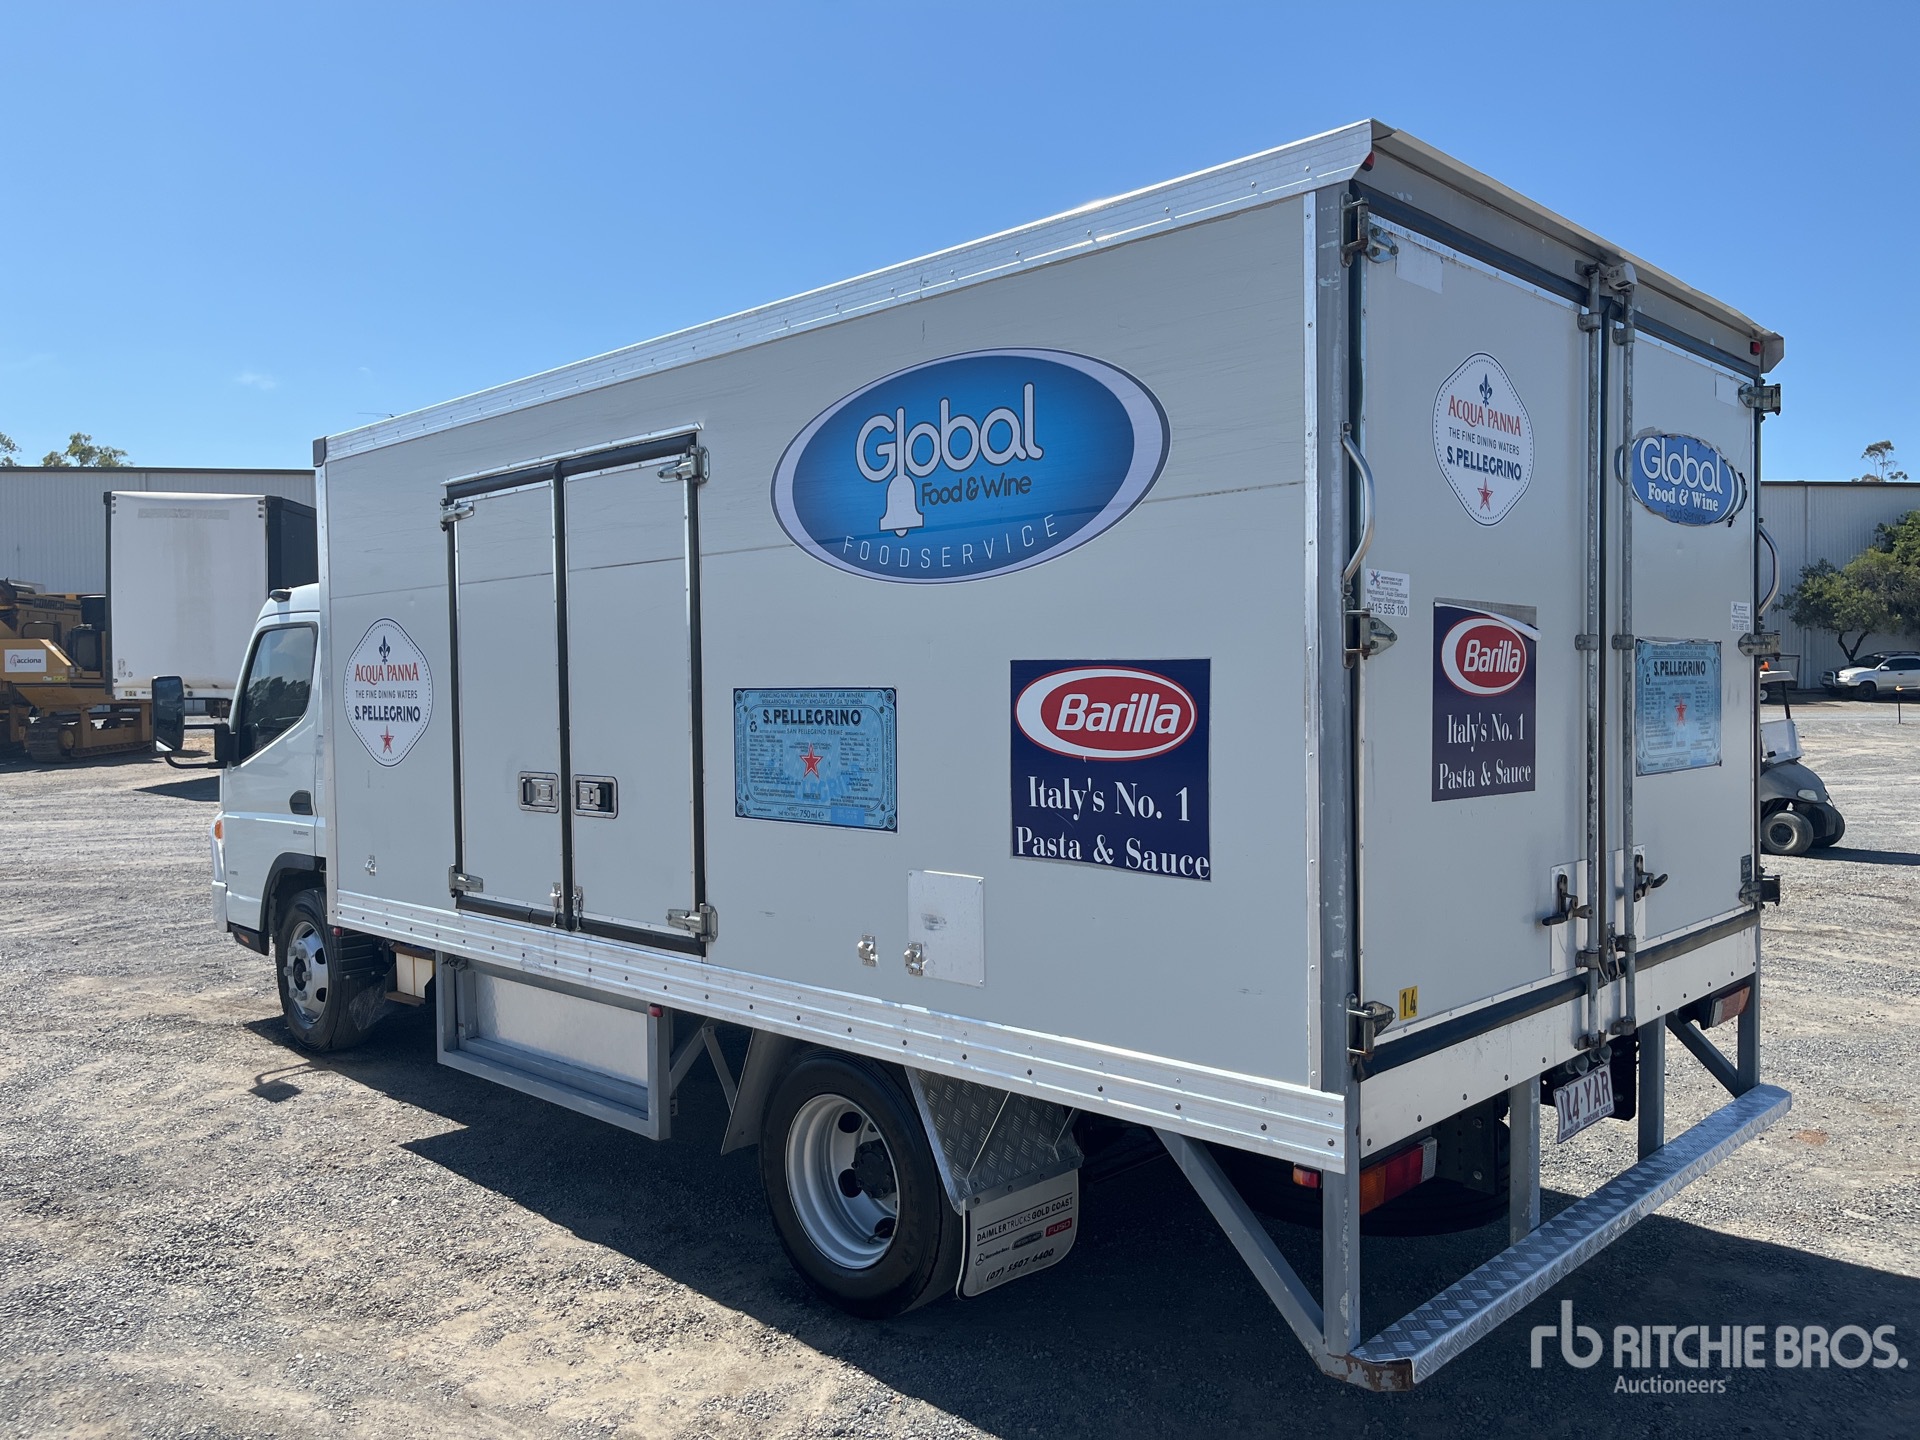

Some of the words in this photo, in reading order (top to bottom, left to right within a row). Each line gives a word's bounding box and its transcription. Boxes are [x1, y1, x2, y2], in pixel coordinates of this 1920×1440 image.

[855, 381, 1044, 482] Global
[1448, 395, 1484, 428] ACQUA
[1487, 408, 1522, 437] PANNA
[1449, 427, 1461, 439] THE
[1462, 430, 1476, 444] FINE
[1477, 434, 1497, 450] DINING
[1498, 440, 1520, 456] WATERS
[1447, 446, 1522, 481] S.PELLEGRINO
[1640, 437, 1723, 495] Global
[921, 475, 962, 507] Food
[965, 476, 980, 498] &
[980, 472, 1033, 498] Wine
[1648, 482, 1676, 504] Food
[1679, 489, 1689, 506] &
[1692, 491, 1718, 512] Wine
[843, 513, 1058, 569] FOODSERVICE
[1383, 603, 1396, 615] 555
[1397, 605, 1408, 616] 100
[1463, 639, 1521, 673] Barilla
[1653, 660, 1706, 676] S.PELLEGRINO
[355, 664, 385, 685] ACQUA
[387, 662, 419, 681] PANNA
[355, 690, 364, 699] THE
[366, 690, 377, 699] FINE
[379, 690, 396, 699] DINING
[397, 690, 418, 699] WATERS
[354, 705, 421, 722] S.PELLEGRINO
[763, 708, 862, 727] S.PELLEGRINO
[1056, 693, 1181, 734] Barilla
[1447, 712, 1487, 753] Italy's
[1491, 713, 1513, 742] No.
[1517, 713, 1525, 741] 1
[1439, 763, 1475, 790] Pasta
[1480, 761, 1491, 787] &
[1495, 759, 1531, 785] Sauce
[1027, 776, 1105, 821] Italy's
[1114, 781, 1163, 819] No.
[1175, 786, 1190, 822] 1
[1016, 825, 1082, 860] Pasta
[1093, 834, 1115, 864] &
[1125, 837, 1210, 878] Sauce
[1401, 991, 1417, 1017] 14
[1583, 1110, 1600, 1125] SUNSHINE
[1600, 1104, 1612, 1116] STATE
[1031, 1206, 1050, 1220] GOLD
[1051, 1197, 1073, 1212] COAST
[1048, 1220, 1072, 1236] FUSO
[986, 1267, 1005, 1282] (07)
[1007, 1257, 1030, 1273] 5507
[1032, 1248, 1055, 1263] 6400
